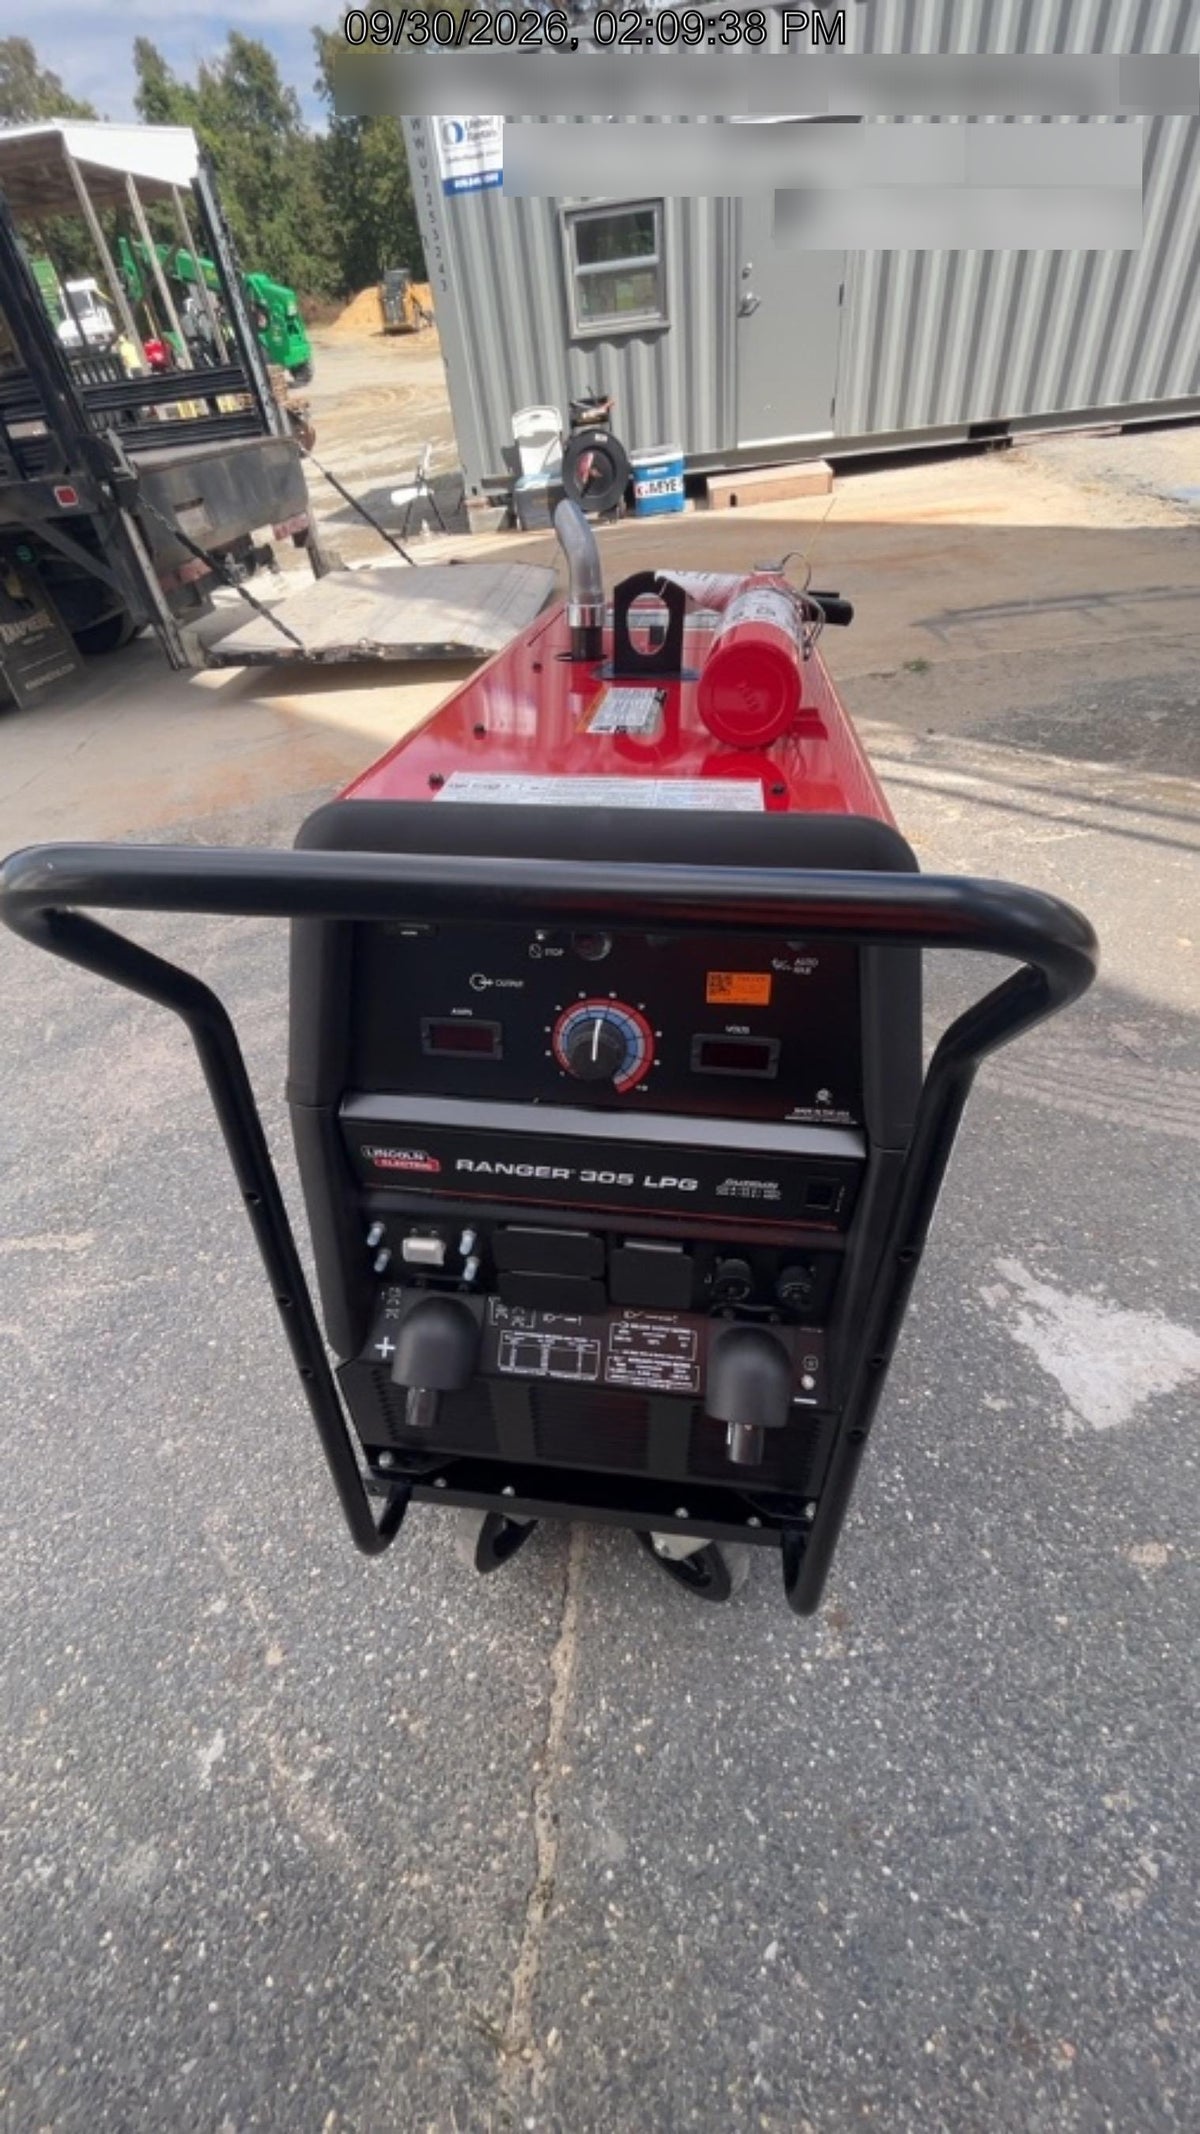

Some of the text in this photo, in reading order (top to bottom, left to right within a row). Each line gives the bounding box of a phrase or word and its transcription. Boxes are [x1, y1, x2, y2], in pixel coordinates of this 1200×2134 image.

[455, 1158, 699, 1192] RANGER 305 LPG
